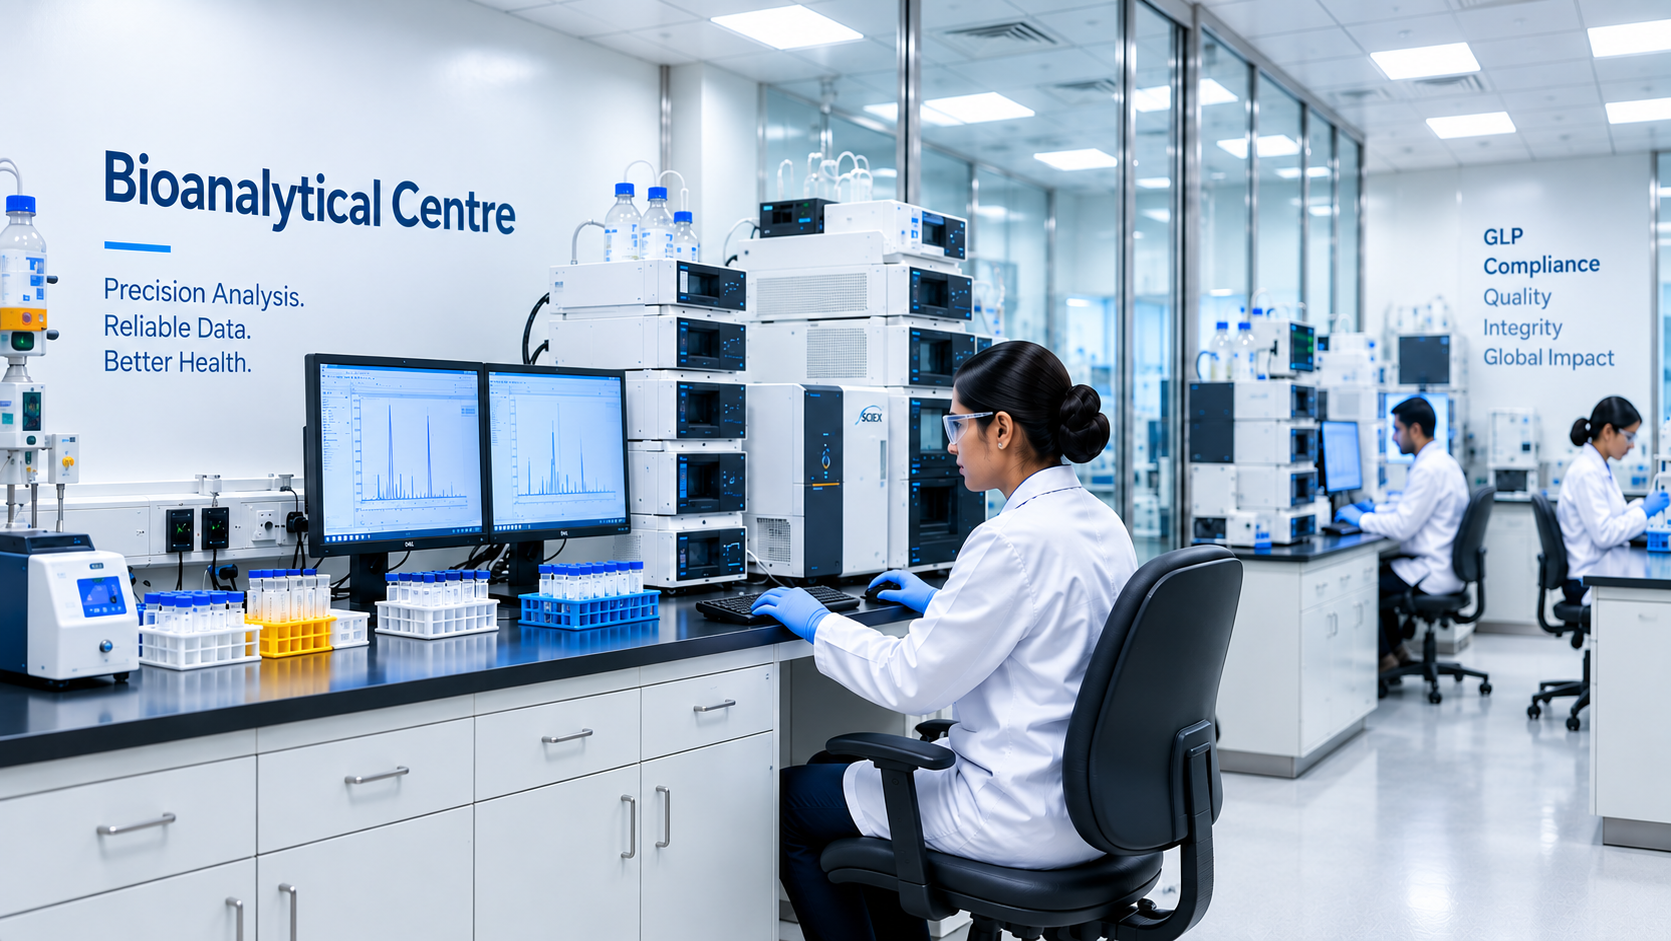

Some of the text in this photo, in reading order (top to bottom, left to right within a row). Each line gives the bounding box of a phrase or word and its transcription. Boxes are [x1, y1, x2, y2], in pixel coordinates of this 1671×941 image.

[104, 150, 517, 236] Bioanalytical Centre
[1483, 227, 1524, 247] GLP
[1483, 254, 1601, 279] Compliance
[104, 276, 305, 312] Precision Analysis.
[1483, 287, 1552, 310] Quality
[104, 313, 251, 340] Reliable Data.
[1483, 318, 1563, 341] Integrity
[104, 349, 252, 373] Better Health.
[1483, 347, 1615, 371] Global Impact
